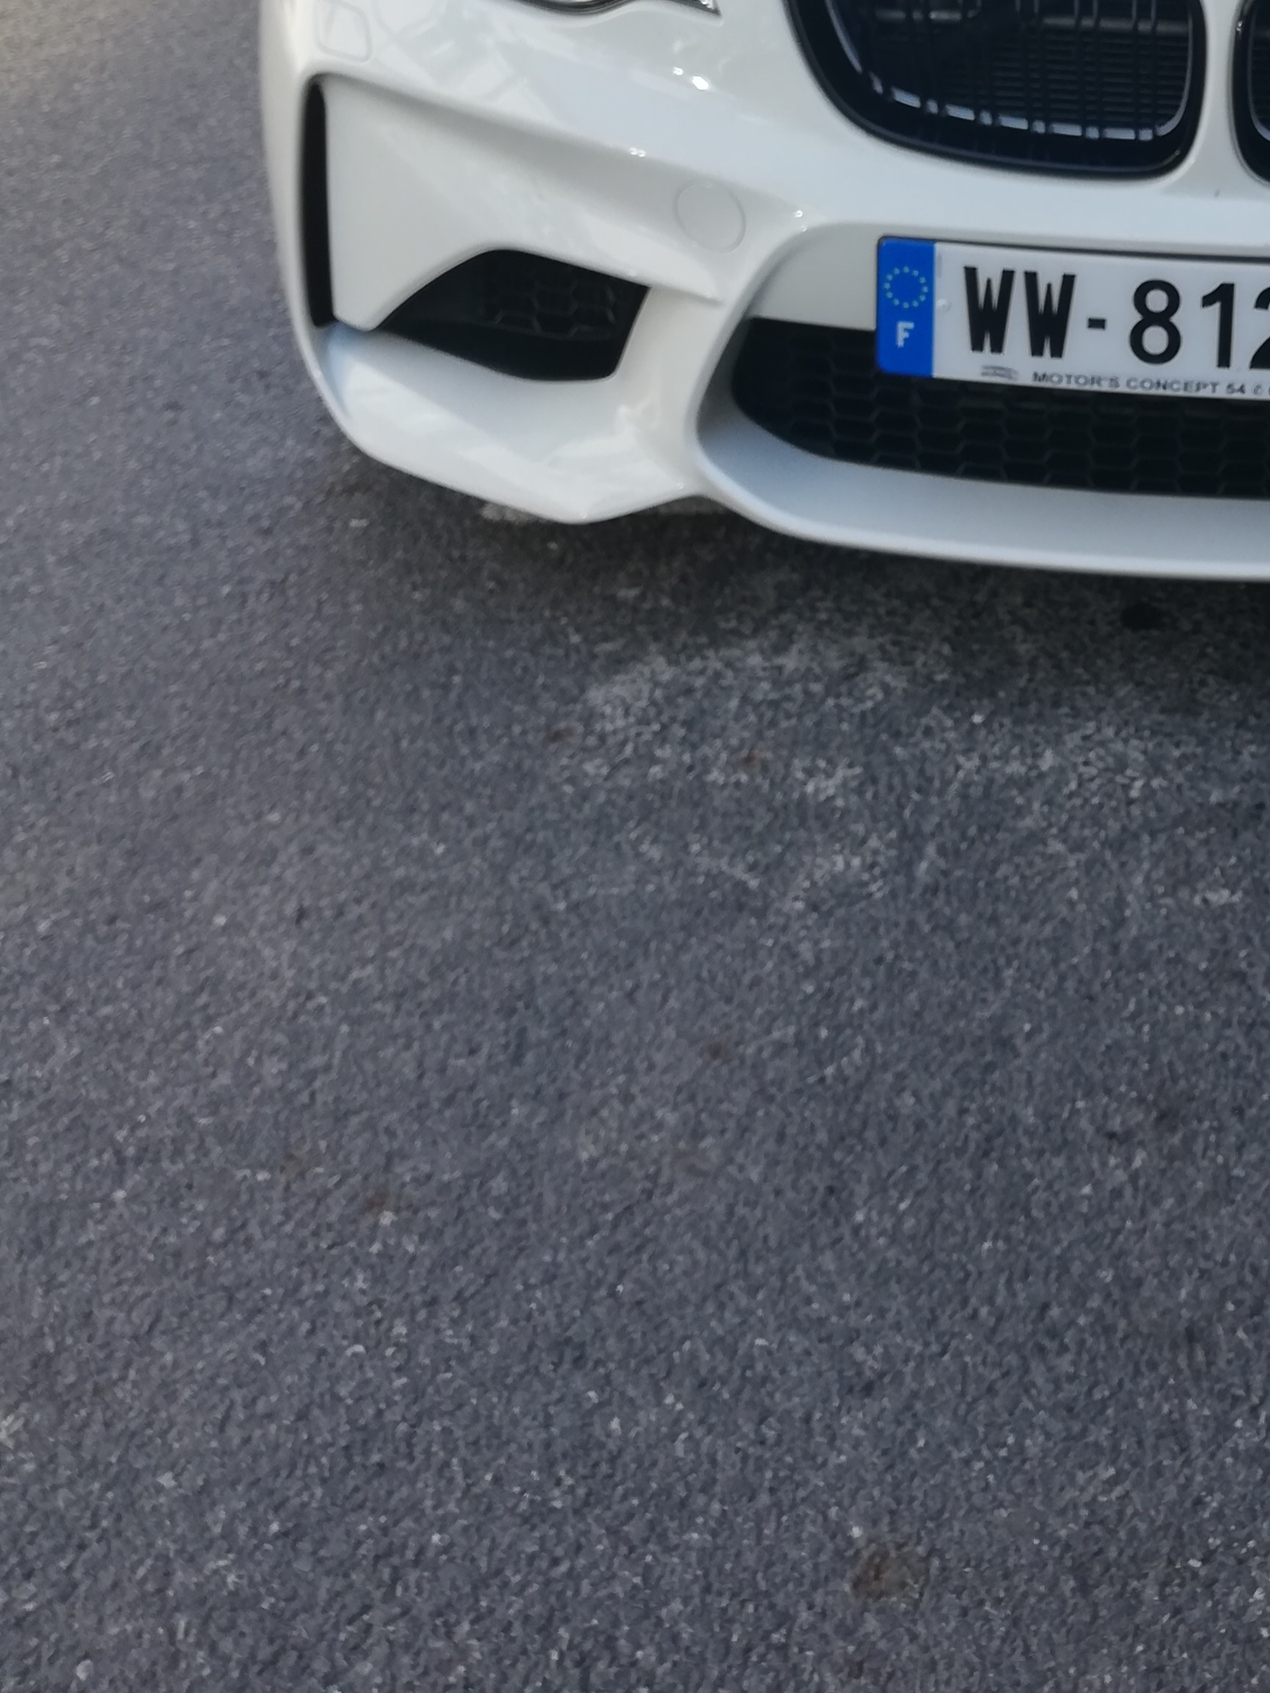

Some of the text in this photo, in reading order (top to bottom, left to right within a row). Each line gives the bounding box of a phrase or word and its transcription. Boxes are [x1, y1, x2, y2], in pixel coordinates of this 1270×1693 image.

[896, 321, 915, 348] F
[1126, 377, 1219, 395] CONCEPT
[1225, 383, 1246, 396] 54
